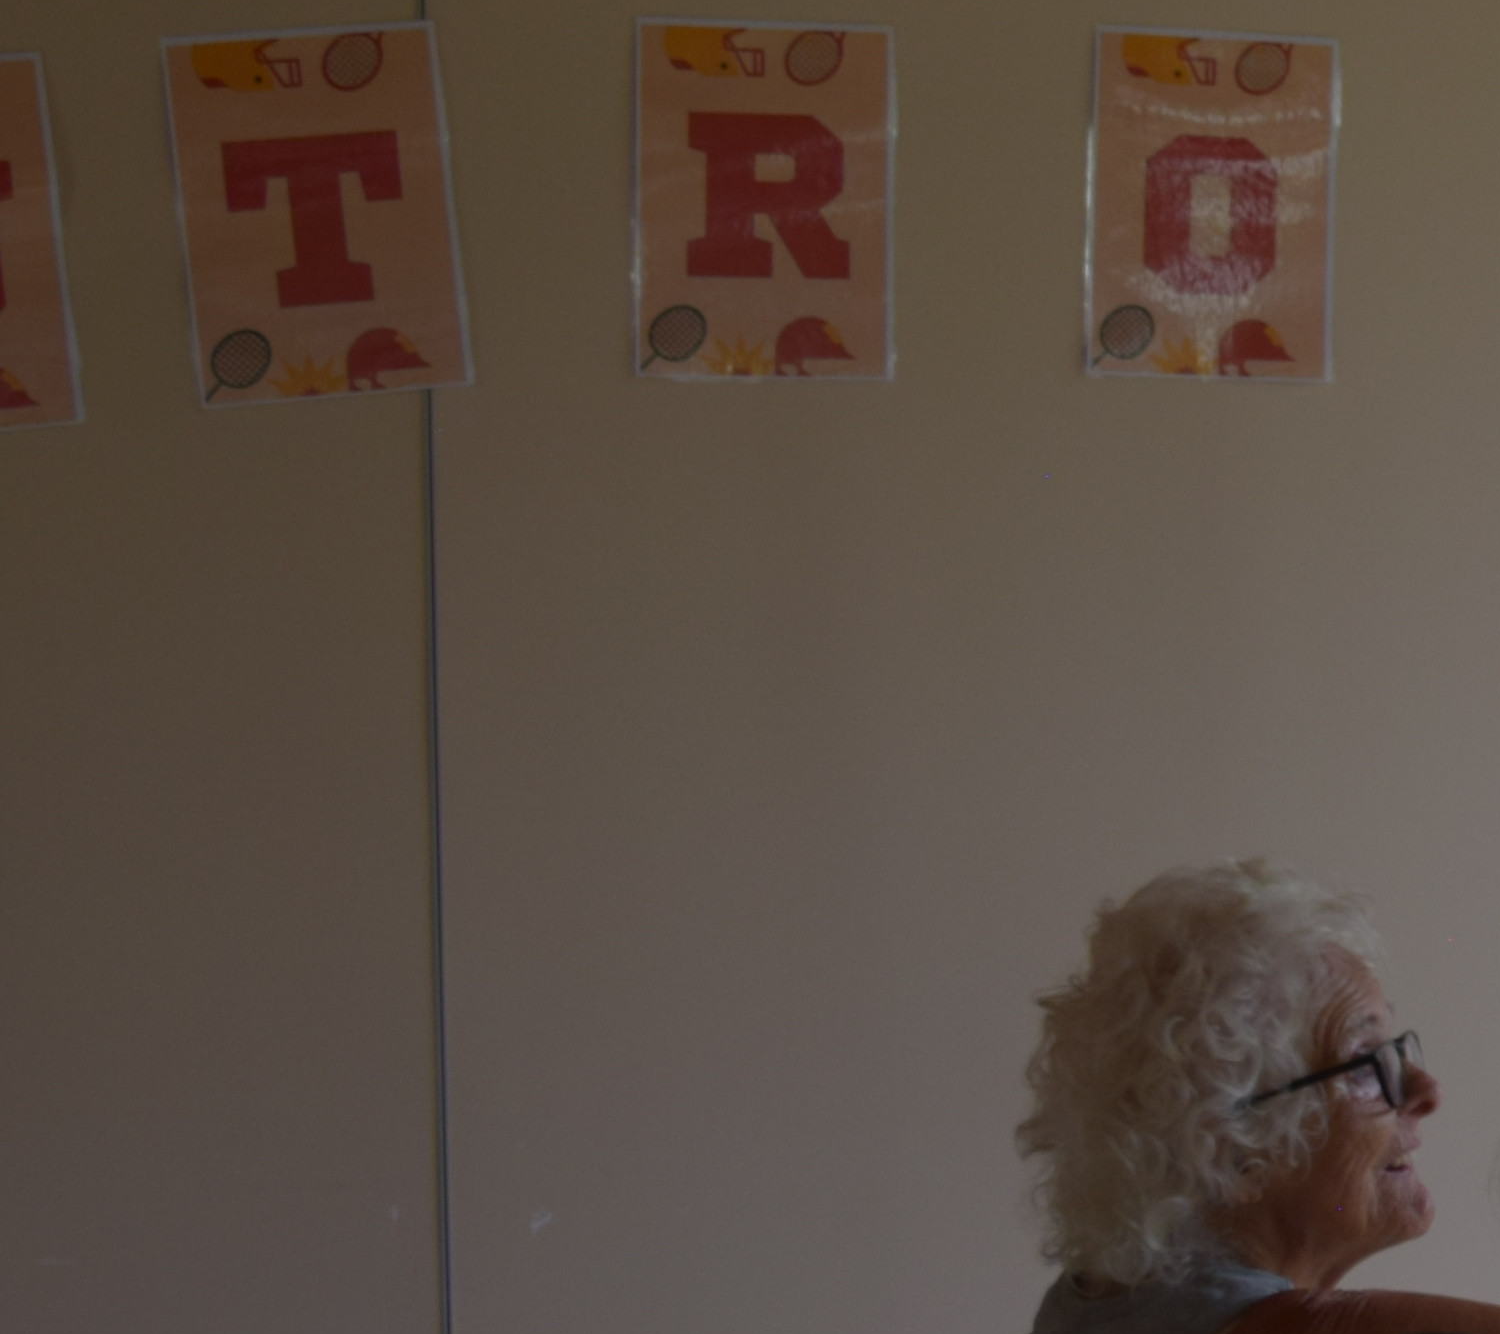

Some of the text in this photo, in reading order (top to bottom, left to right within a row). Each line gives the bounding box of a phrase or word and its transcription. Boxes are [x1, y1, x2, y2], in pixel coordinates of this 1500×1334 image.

[220, 111, 1279, 310] T R O
